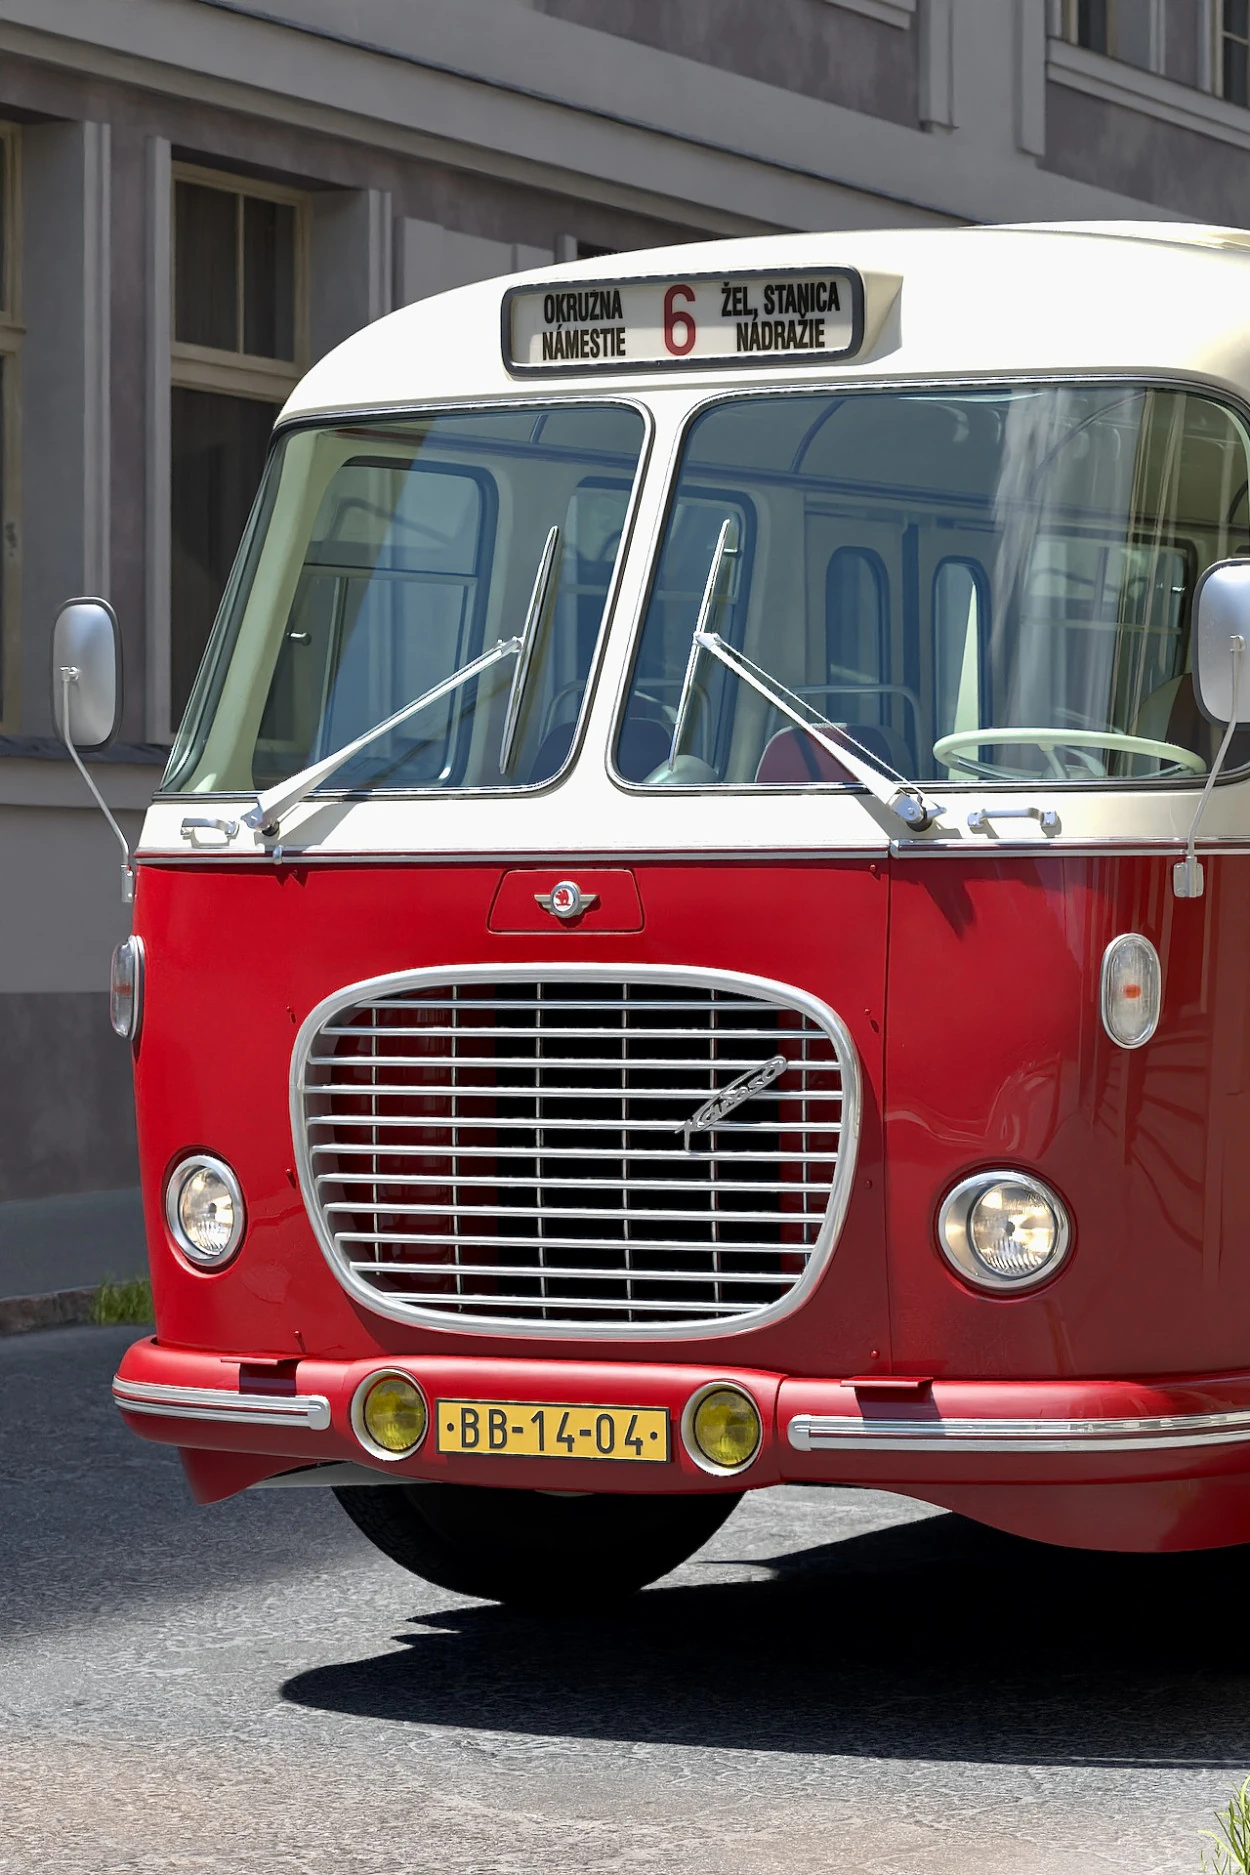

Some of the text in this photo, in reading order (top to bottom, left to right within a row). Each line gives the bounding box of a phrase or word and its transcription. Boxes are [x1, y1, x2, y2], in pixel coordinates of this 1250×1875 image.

[763, 281, 841, 316] STANICA
[663, 284, 696, 356] 6
[542, 323, 627, 361] NÁMESTIE
